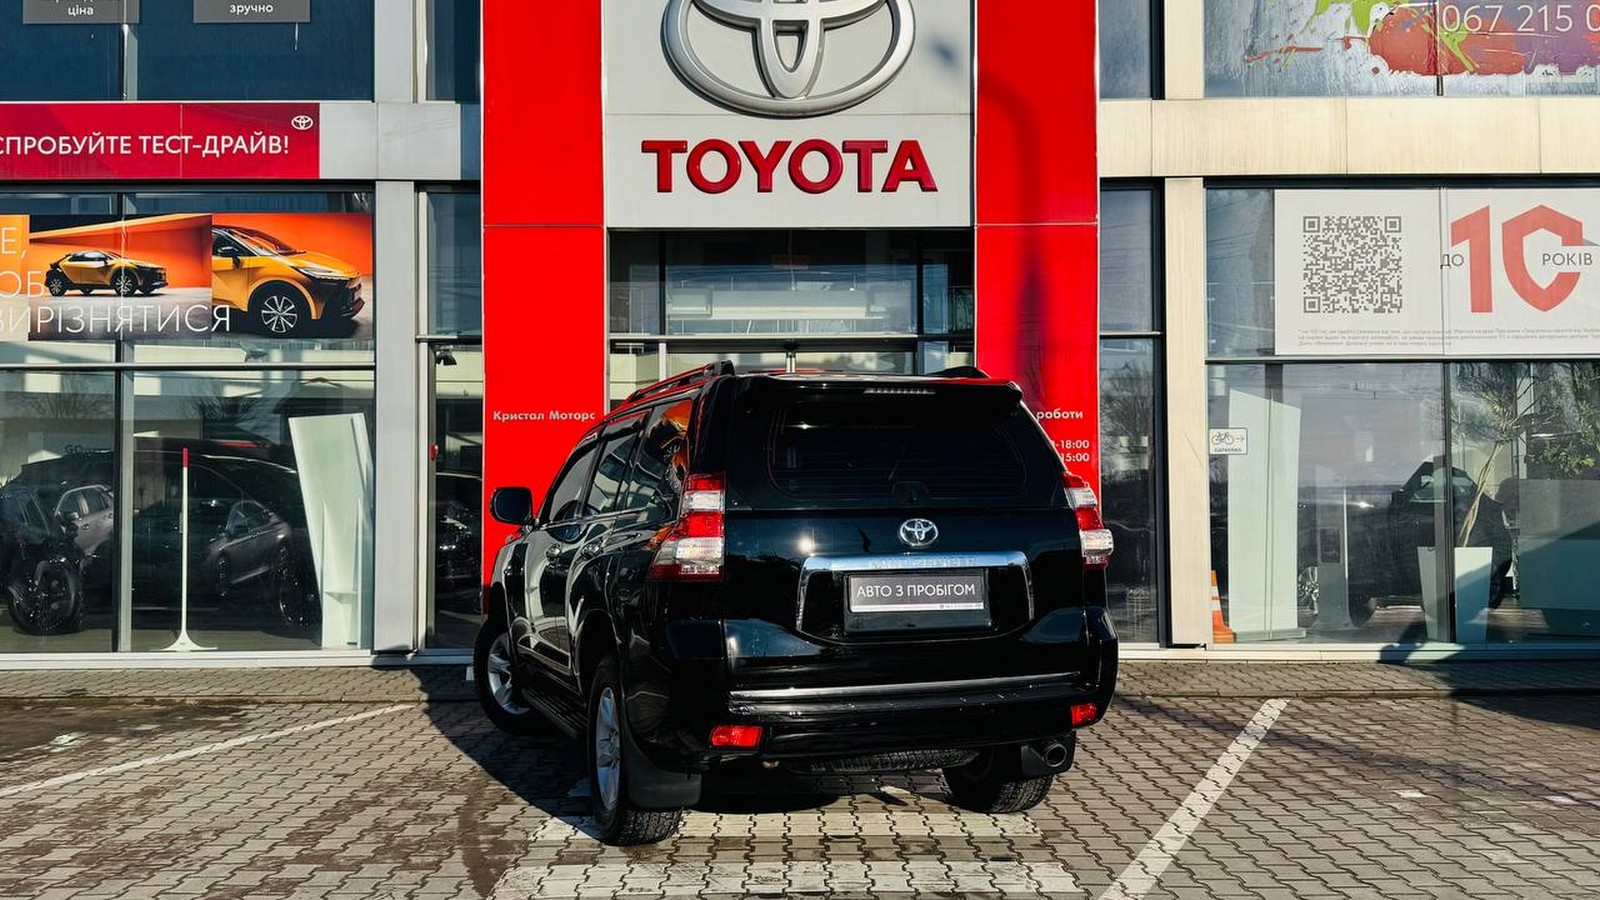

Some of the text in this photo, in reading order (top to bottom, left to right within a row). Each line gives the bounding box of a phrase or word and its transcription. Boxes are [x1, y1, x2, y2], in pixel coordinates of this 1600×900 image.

[68, 5, 94, 16] ціна
[230, 4, 274, 14] зручно
[1442, 5, 1502, 32] 067
[1517, 5, 1573, 32] 215
[139, 131, 289, 158] ТЕСТ-ДРАЙВ!
[641, 139, 938, 194] TOYOTA
[1440, 253, 1465, 269] ДО
[1542, 252, 1593, 266] РОКІВ
[493, 410, 596, 423] Кристал Моторс
[1036, 407, 1084, 421] роботи
[857, 584, 976, 597] АВТО З ПРОБІГОМ
